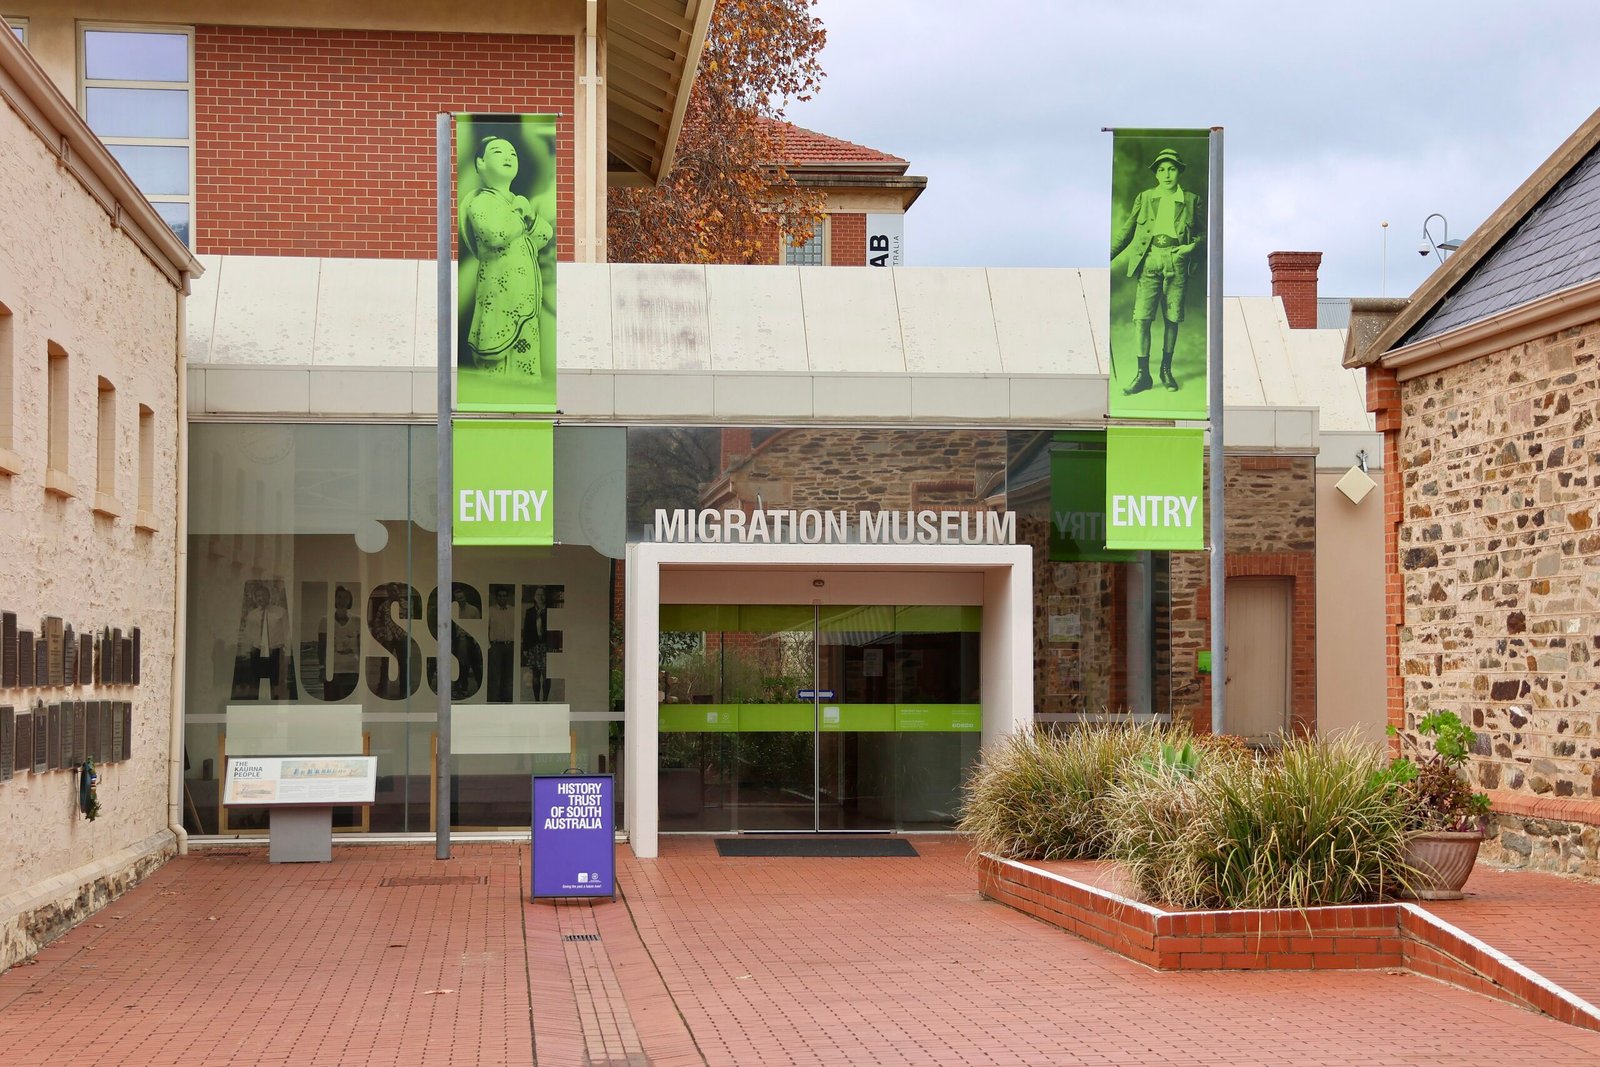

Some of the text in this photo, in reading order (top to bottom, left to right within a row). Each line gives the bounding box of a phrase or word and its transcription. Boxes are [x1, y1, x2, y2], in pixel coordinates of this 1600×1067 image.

[460, 490, 547, 522] ENTRY
[1112, 495, 1197, 527] ENTRY
[655, 508, 850, 544] MIGRATION
[859, 510, 1017, 545] MUSEUM
[231, 580, 565, 702] AUSSIE
[557, 783, 602, 794] HISTORY
[568, 795, 602, 806] TRUST
[551, 806, 602, 817] OF SOUTH
[544, 818, 602, 829] AUSTRALIA
